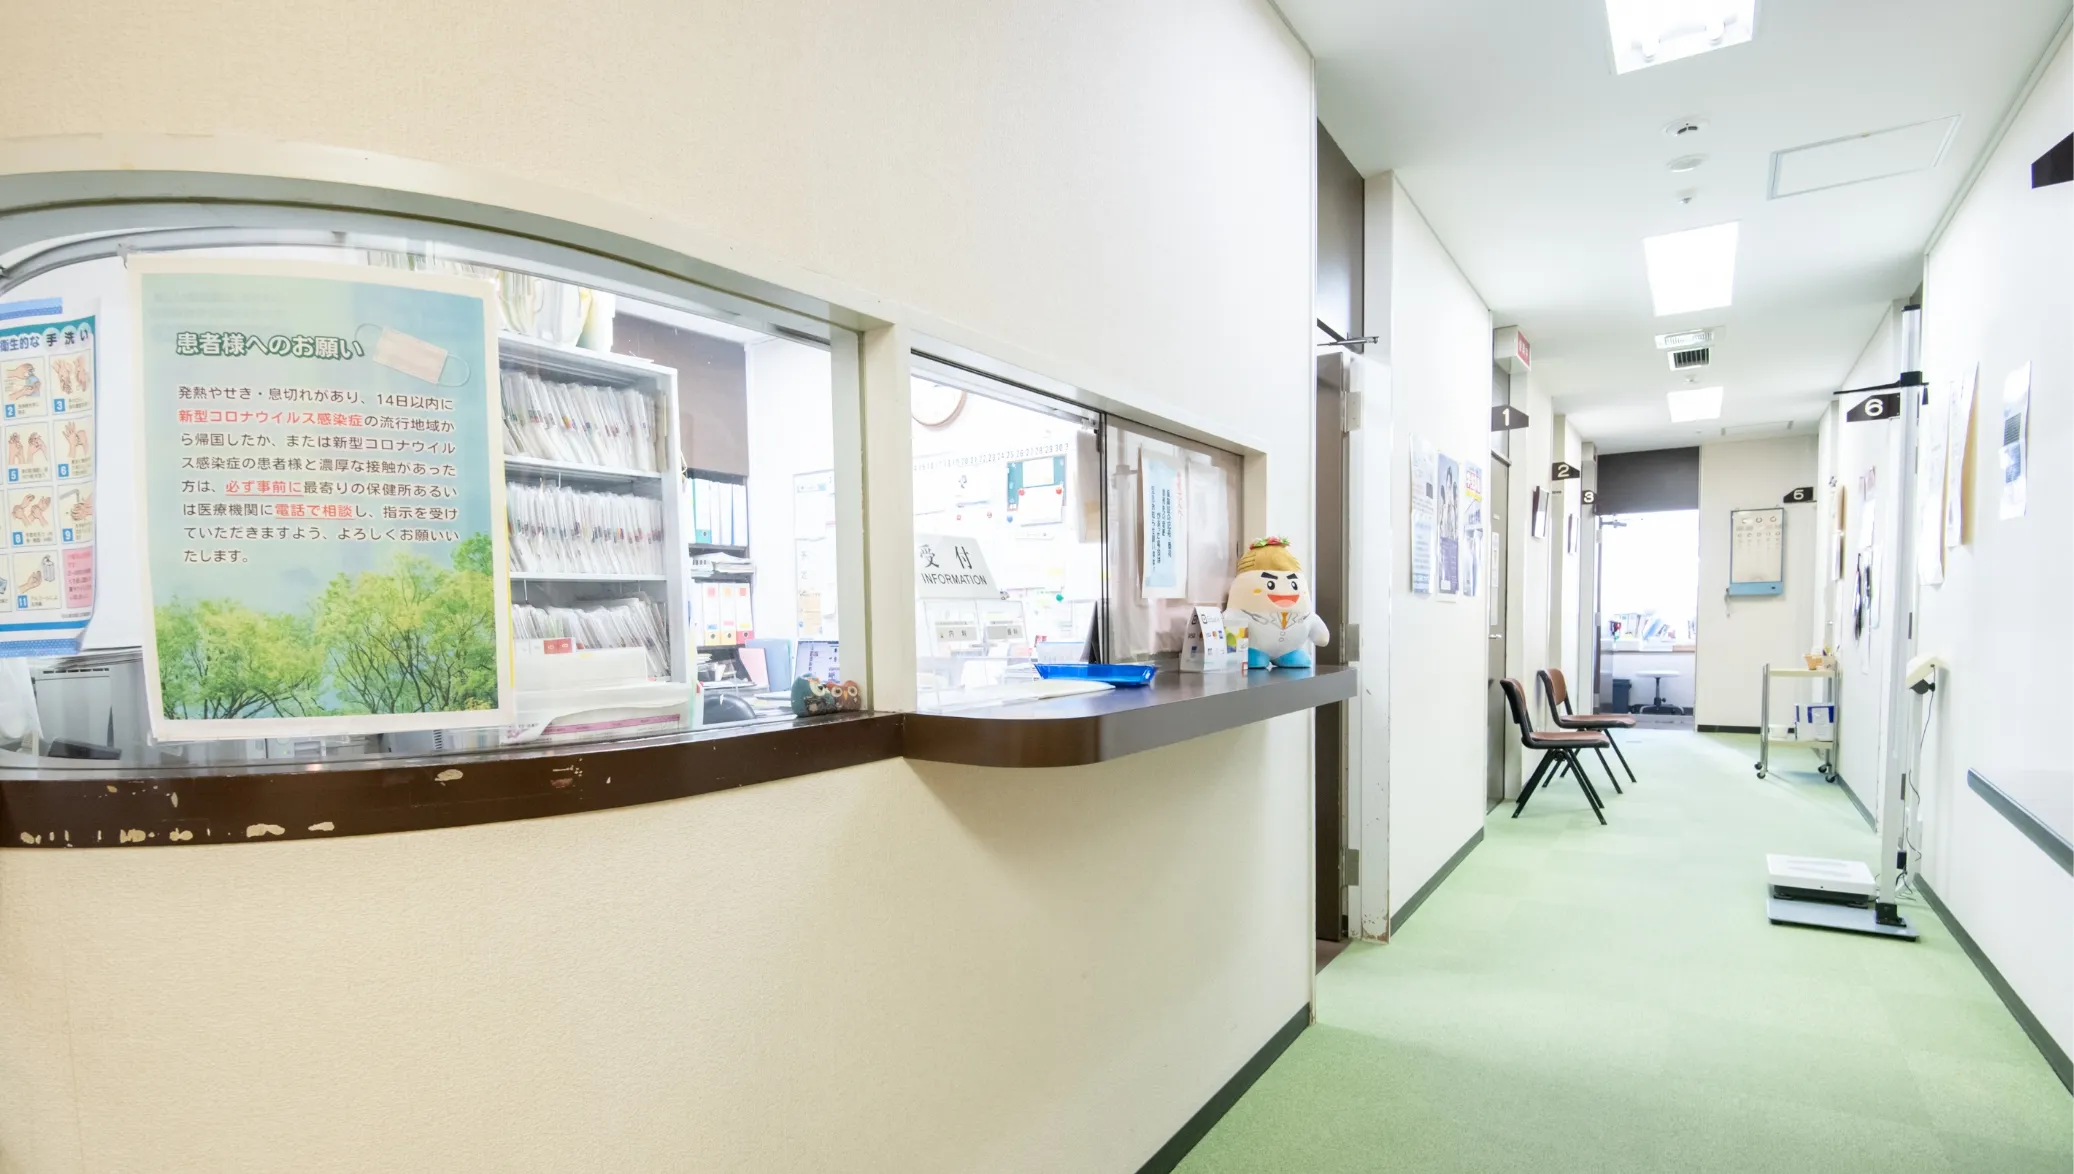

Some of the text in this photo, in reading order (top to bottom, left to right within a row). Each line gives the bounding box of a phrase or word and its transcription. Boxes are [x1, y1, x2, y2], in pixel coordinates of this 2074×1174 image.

[176, 331, 365, 360] 患者様へのお願い
[1864, 398, 1884, 417] 6
[1502, 408, 1510, 427] 1
[180, 433, 456, 455] ら帰国したか、または新型コロナウイル
[181, 456, 457, 477] ス感染症の患者様と濃厚な接触があった
[1557, 464, 1570, 478] 2
[181, 480, 458, 498] 方は、必ず事前に最寄りの保健所あるい
[1583, 491, 1594, 503] 3
[183, 502, 458, 521] は医療機関に電話で相談し、指示を受け
[184, 526, 460, 542] ていただきますよう、よろしくお願いい
[184, 550, 249, 563] たします。
[921, 573, 987, 585] INFORMATION
